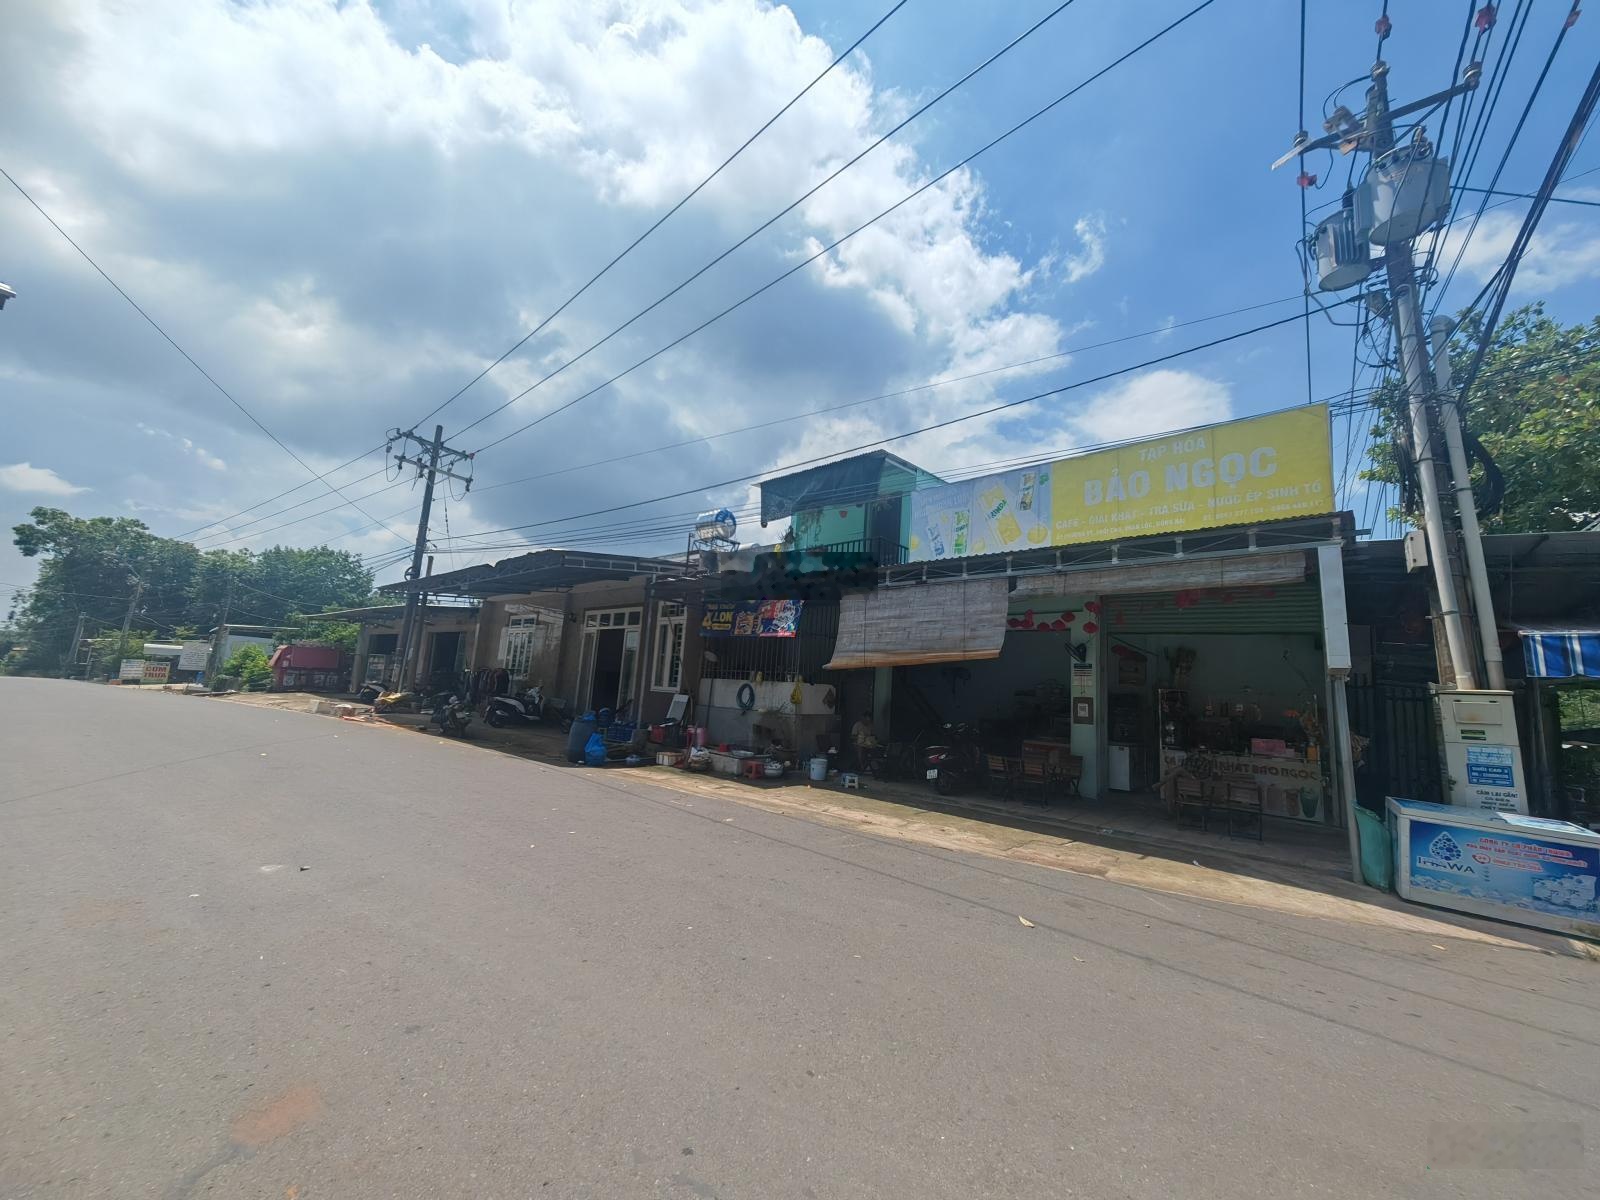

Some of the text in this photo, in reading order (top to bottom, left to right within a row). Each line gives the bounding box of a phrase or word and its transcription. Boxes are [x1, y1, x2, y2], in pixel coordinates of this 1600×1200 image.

[1084, 446, 1278, 507] BẢO NGỌC
[1267, 486, 1299, 500] SINH
